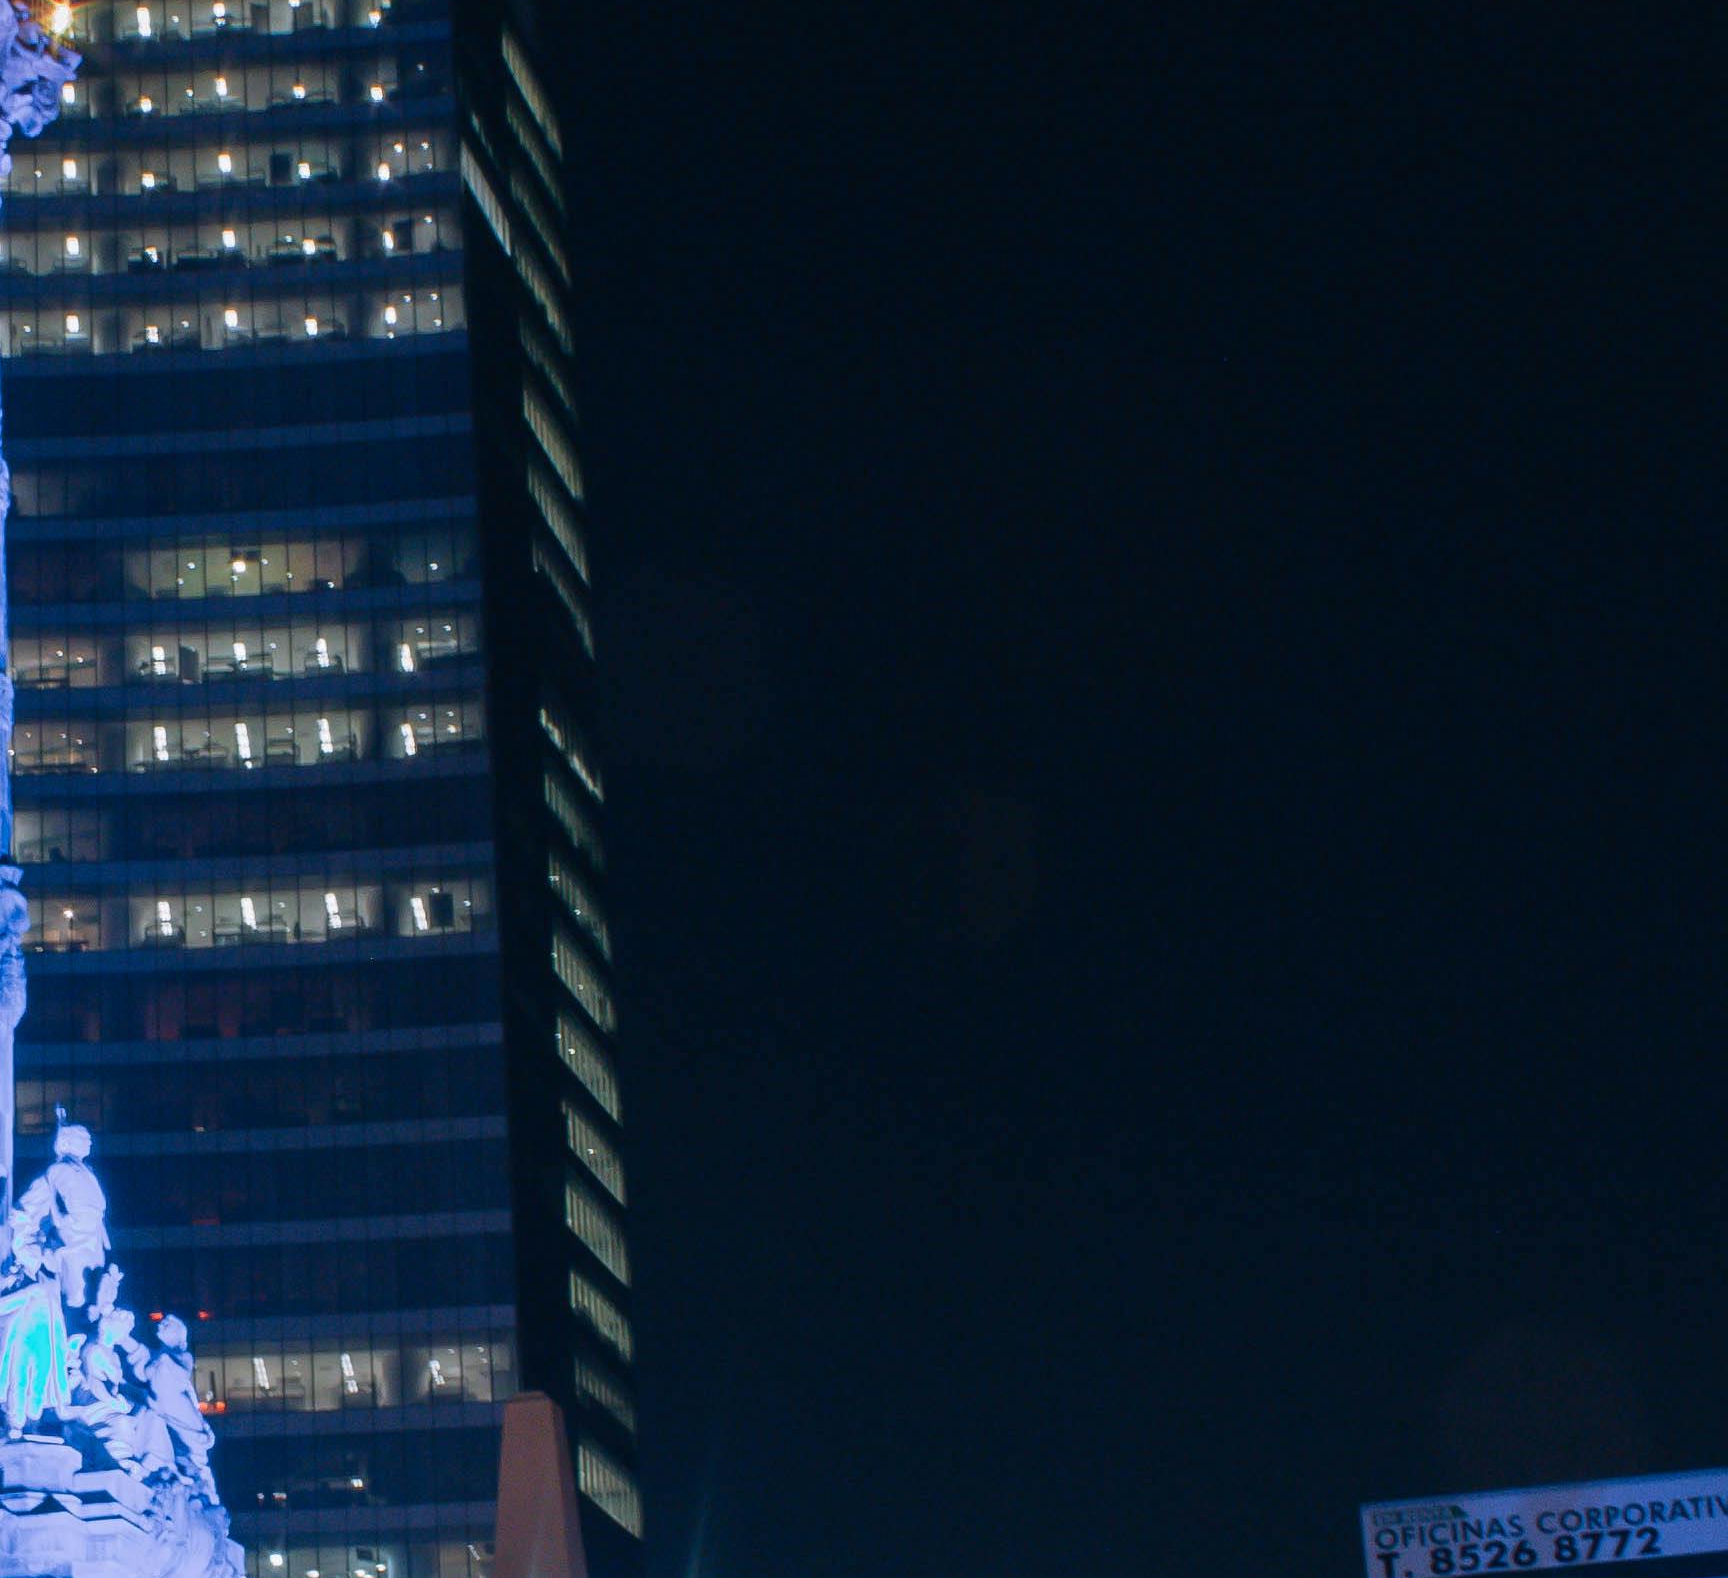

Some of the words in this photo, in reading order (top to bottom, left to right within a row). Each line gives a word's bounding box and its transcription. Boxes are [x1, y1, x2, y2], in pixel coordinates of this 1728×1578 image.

[1375, 1514, 1523, 1551] OFICINAS
[1429, 1540, 1538, 1576] 8526
[1552, 1526, 1662, 1564] 8772
